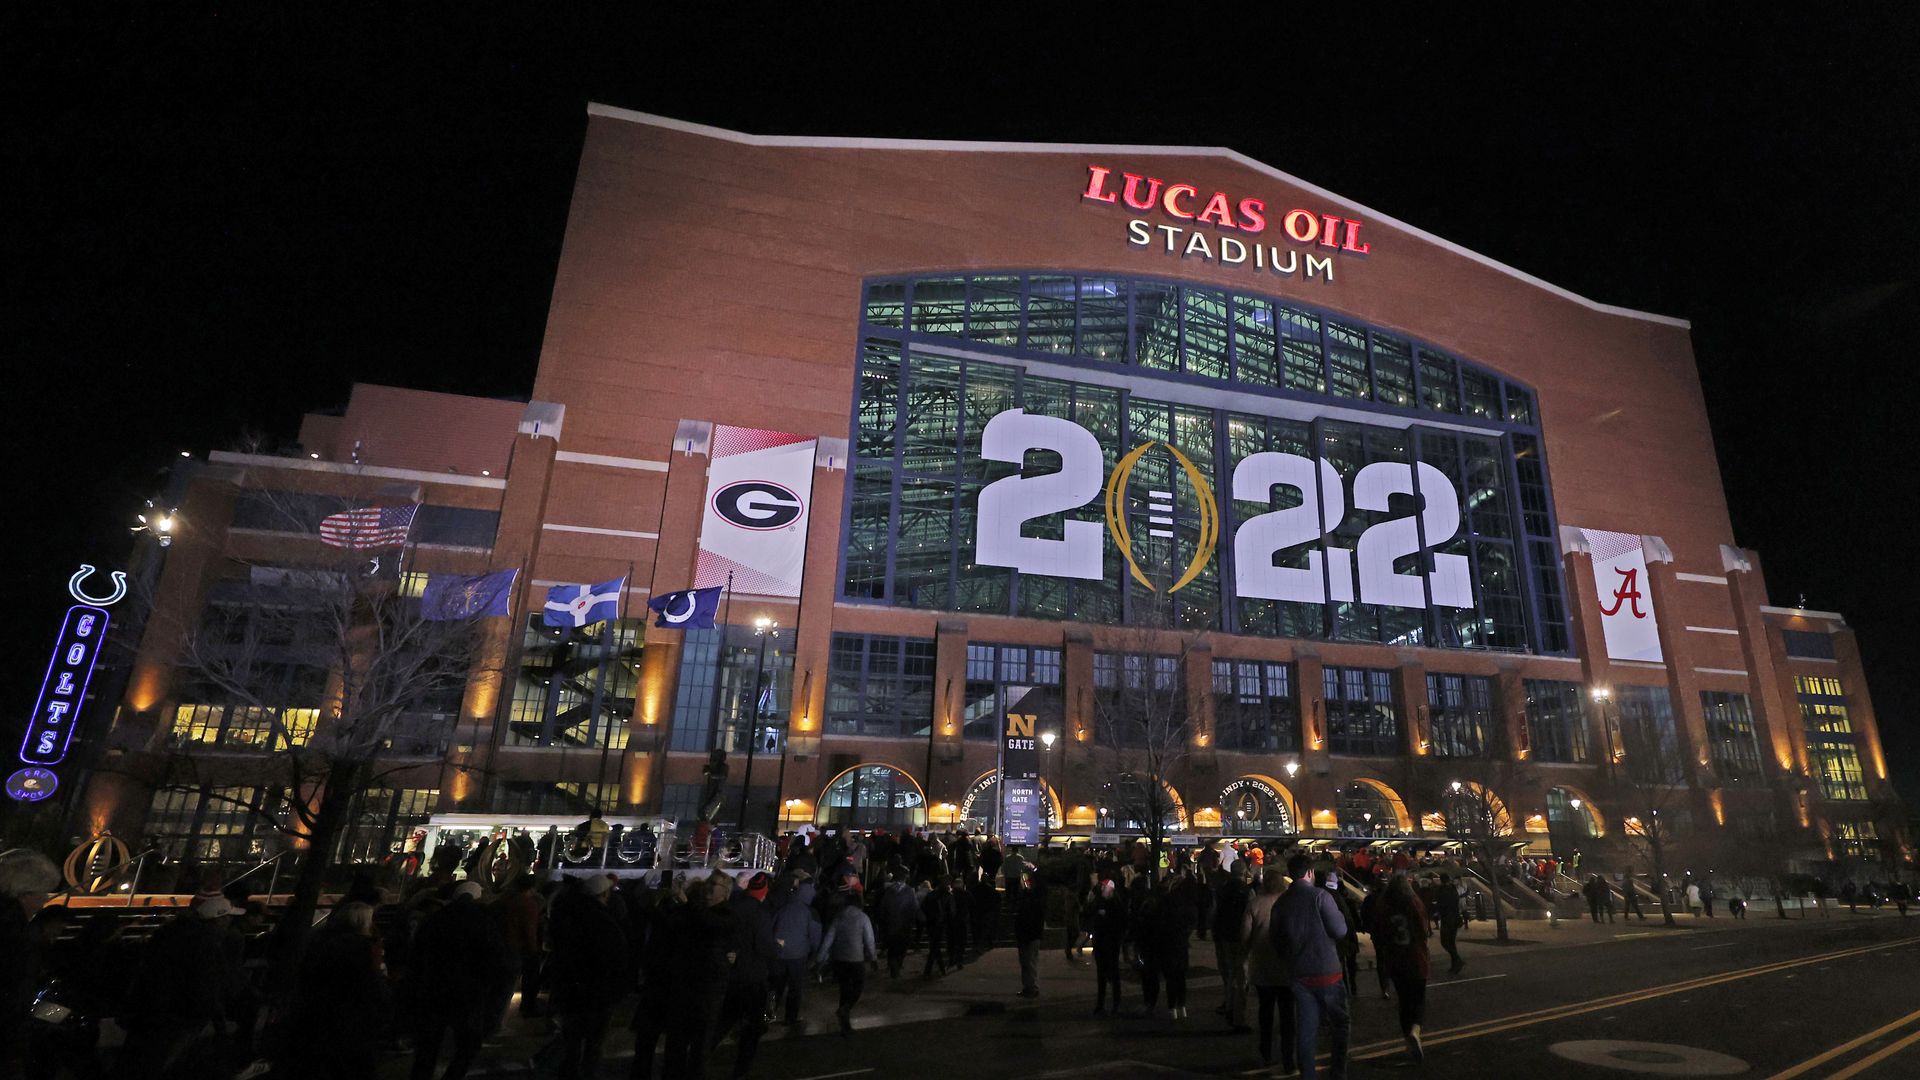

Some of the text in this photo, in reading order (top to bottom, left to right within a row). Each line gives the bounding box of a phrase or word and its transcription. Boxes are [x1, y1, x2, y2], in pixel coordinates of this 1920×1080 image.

[1082, 166, 1370, 255] LUCAS OIL
[1128, 219, 1334, 281] STADIUM
[716, 483, 800, 528] G
[1599, 566, 1647, 619] A
[36, 614, 96, 755] COLTS
[1006, 713, 1037, 737] N
[1008, 738, 1035, 750] GATE
[960, 793, 976, 822] 2022
[1222, 780, 1290, 828] INDY 2022 INDY
